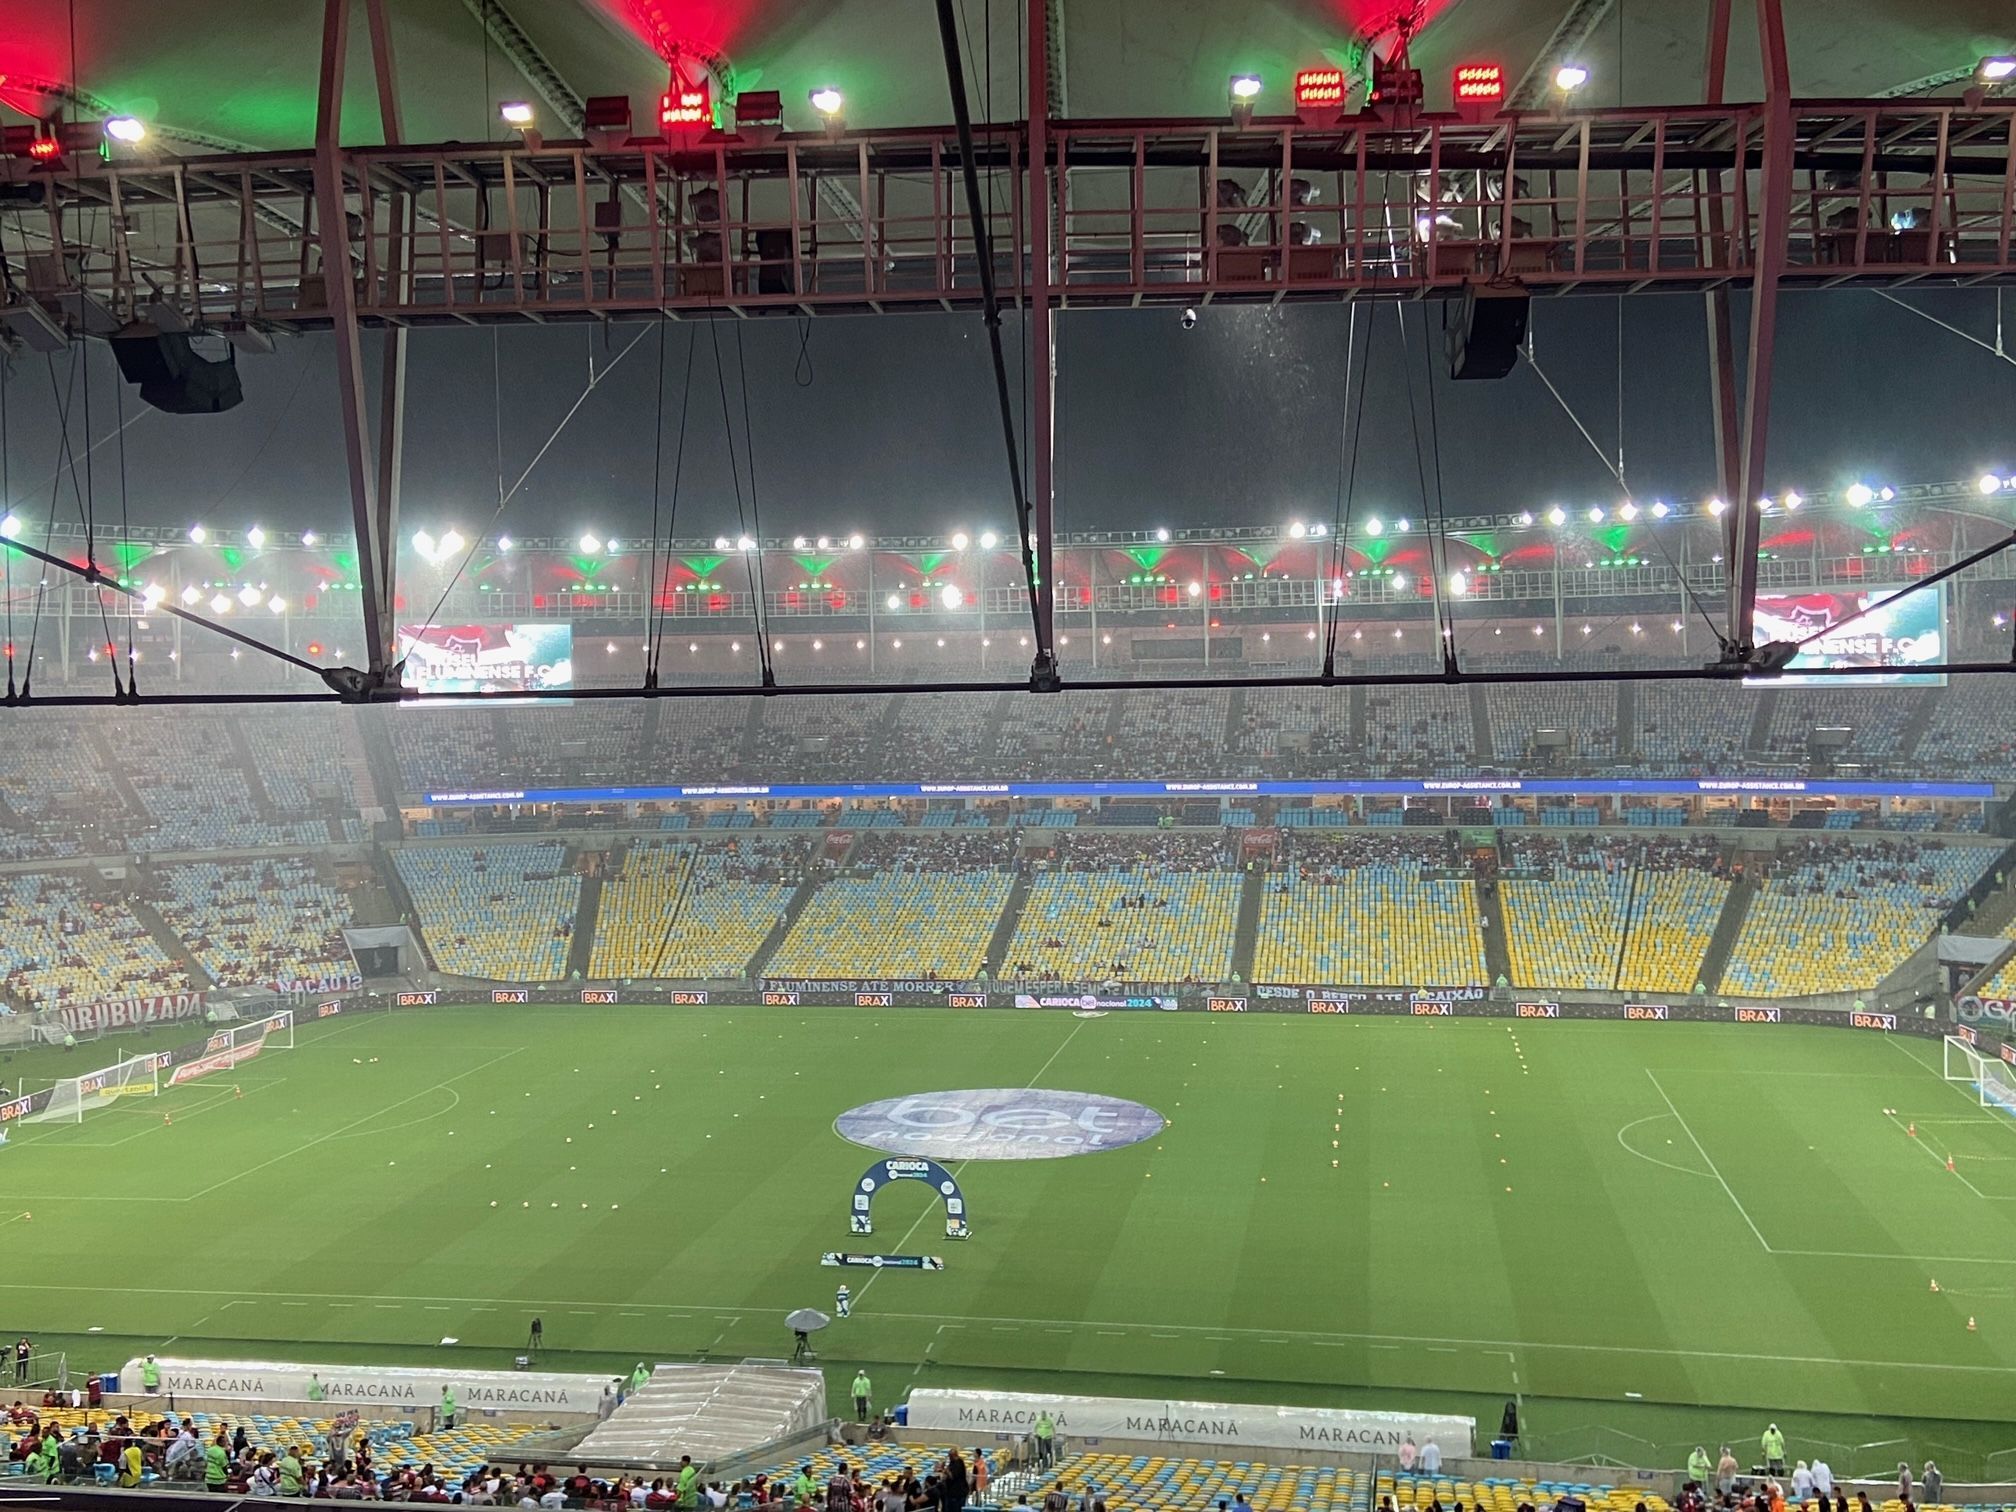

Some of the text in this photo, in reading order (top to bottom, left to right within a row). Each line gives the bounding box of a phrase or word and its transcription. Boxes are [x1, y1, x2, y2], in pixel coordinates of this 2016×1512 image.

[401, 994, 433, 1005] BRAX
[495, 992, 525, 1003] BRAX
[584, 992, 615, 1004] BRAX
[674, 993, 705, 1005] BRAX
[766, 994, 796, 1005] BRAX
[858, 995, 889, 1006] BRAX
[952, 997, 983, 1007] BRAX
[1040, 997, 1080, 1007] CARIOCA
[1127, 998, 1152, 1008] 2024
[61, 992, 201, 1032] URUBUZADA
[1210, 1000, 1244, 1012] BRAX
[1311, 1002, 1345, 1013] BRAX
[1414, 1004, 1449, 1015] BRAX
[1520, 1005, 1555, 1017] BRAX
[1628, 1007, 1664, 1019] BRAX
[1739, 1009, 1777, 1022] BRAX
[1854, 1015, 1892, 1030] BRAX
[1, 1100, 29, 1121] BRAX
[887, 1099, 1118, 1133] bet
[867, 1130, 1103, 1146] nacional
[886, 1160, 929, 1171] CARIOCA
[168, 1376, 264, 1393] MARACANÃ
[468, 1387, 569, 1404] MARACANÃ
[959, 1408, 1068, 1426] MARACAÃ
[1126, 1417, 1239, 1436] MARACANÃ
